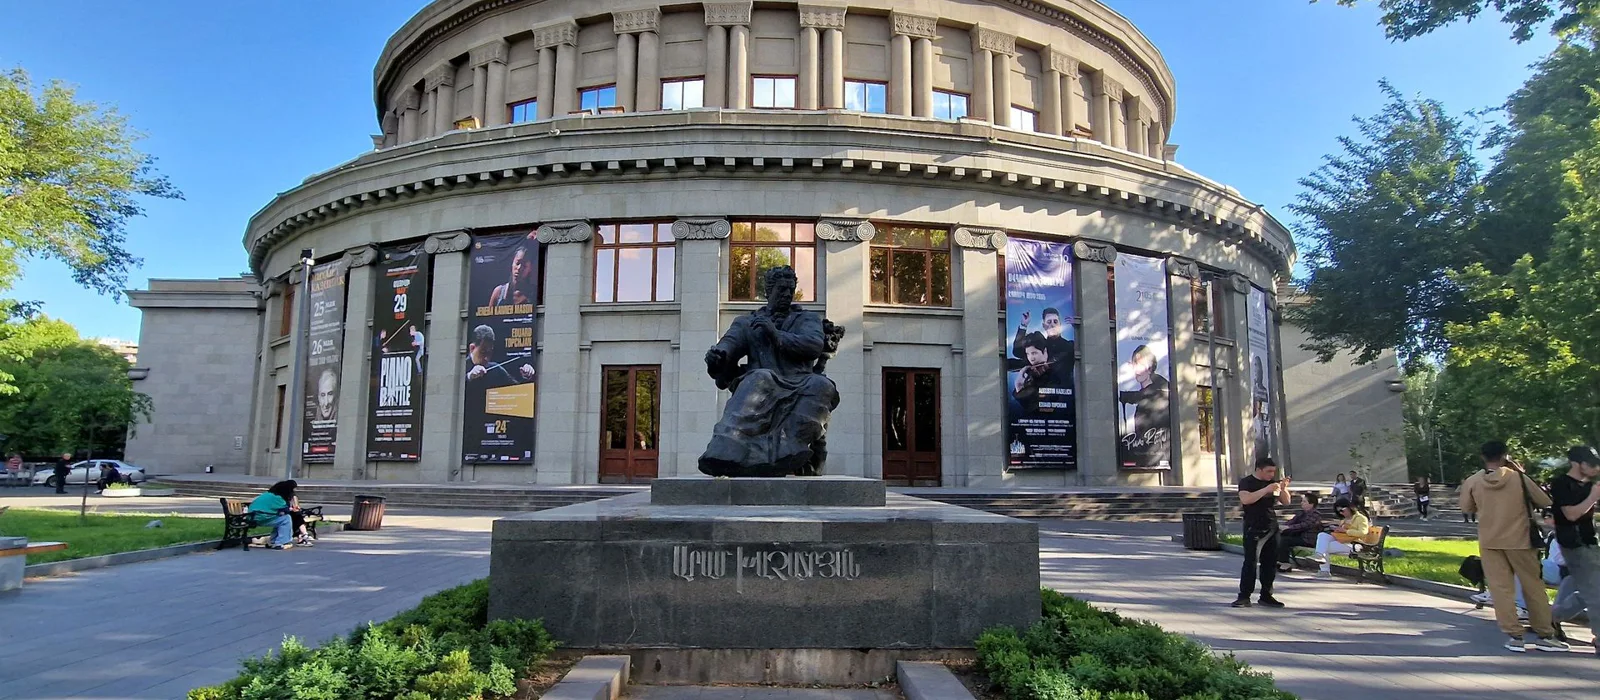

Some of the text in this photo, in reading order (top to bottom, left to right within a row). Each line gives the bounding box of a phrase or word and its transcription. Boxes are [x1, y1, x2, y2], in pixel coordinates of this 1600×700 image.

[313, 300, 325, 317] 25
[394, 294, 407, 313] 29
[311, 339, 323, 355] 26
[380, 356, 412, 387] PIANO
[494, 420, 507, 434] 24
